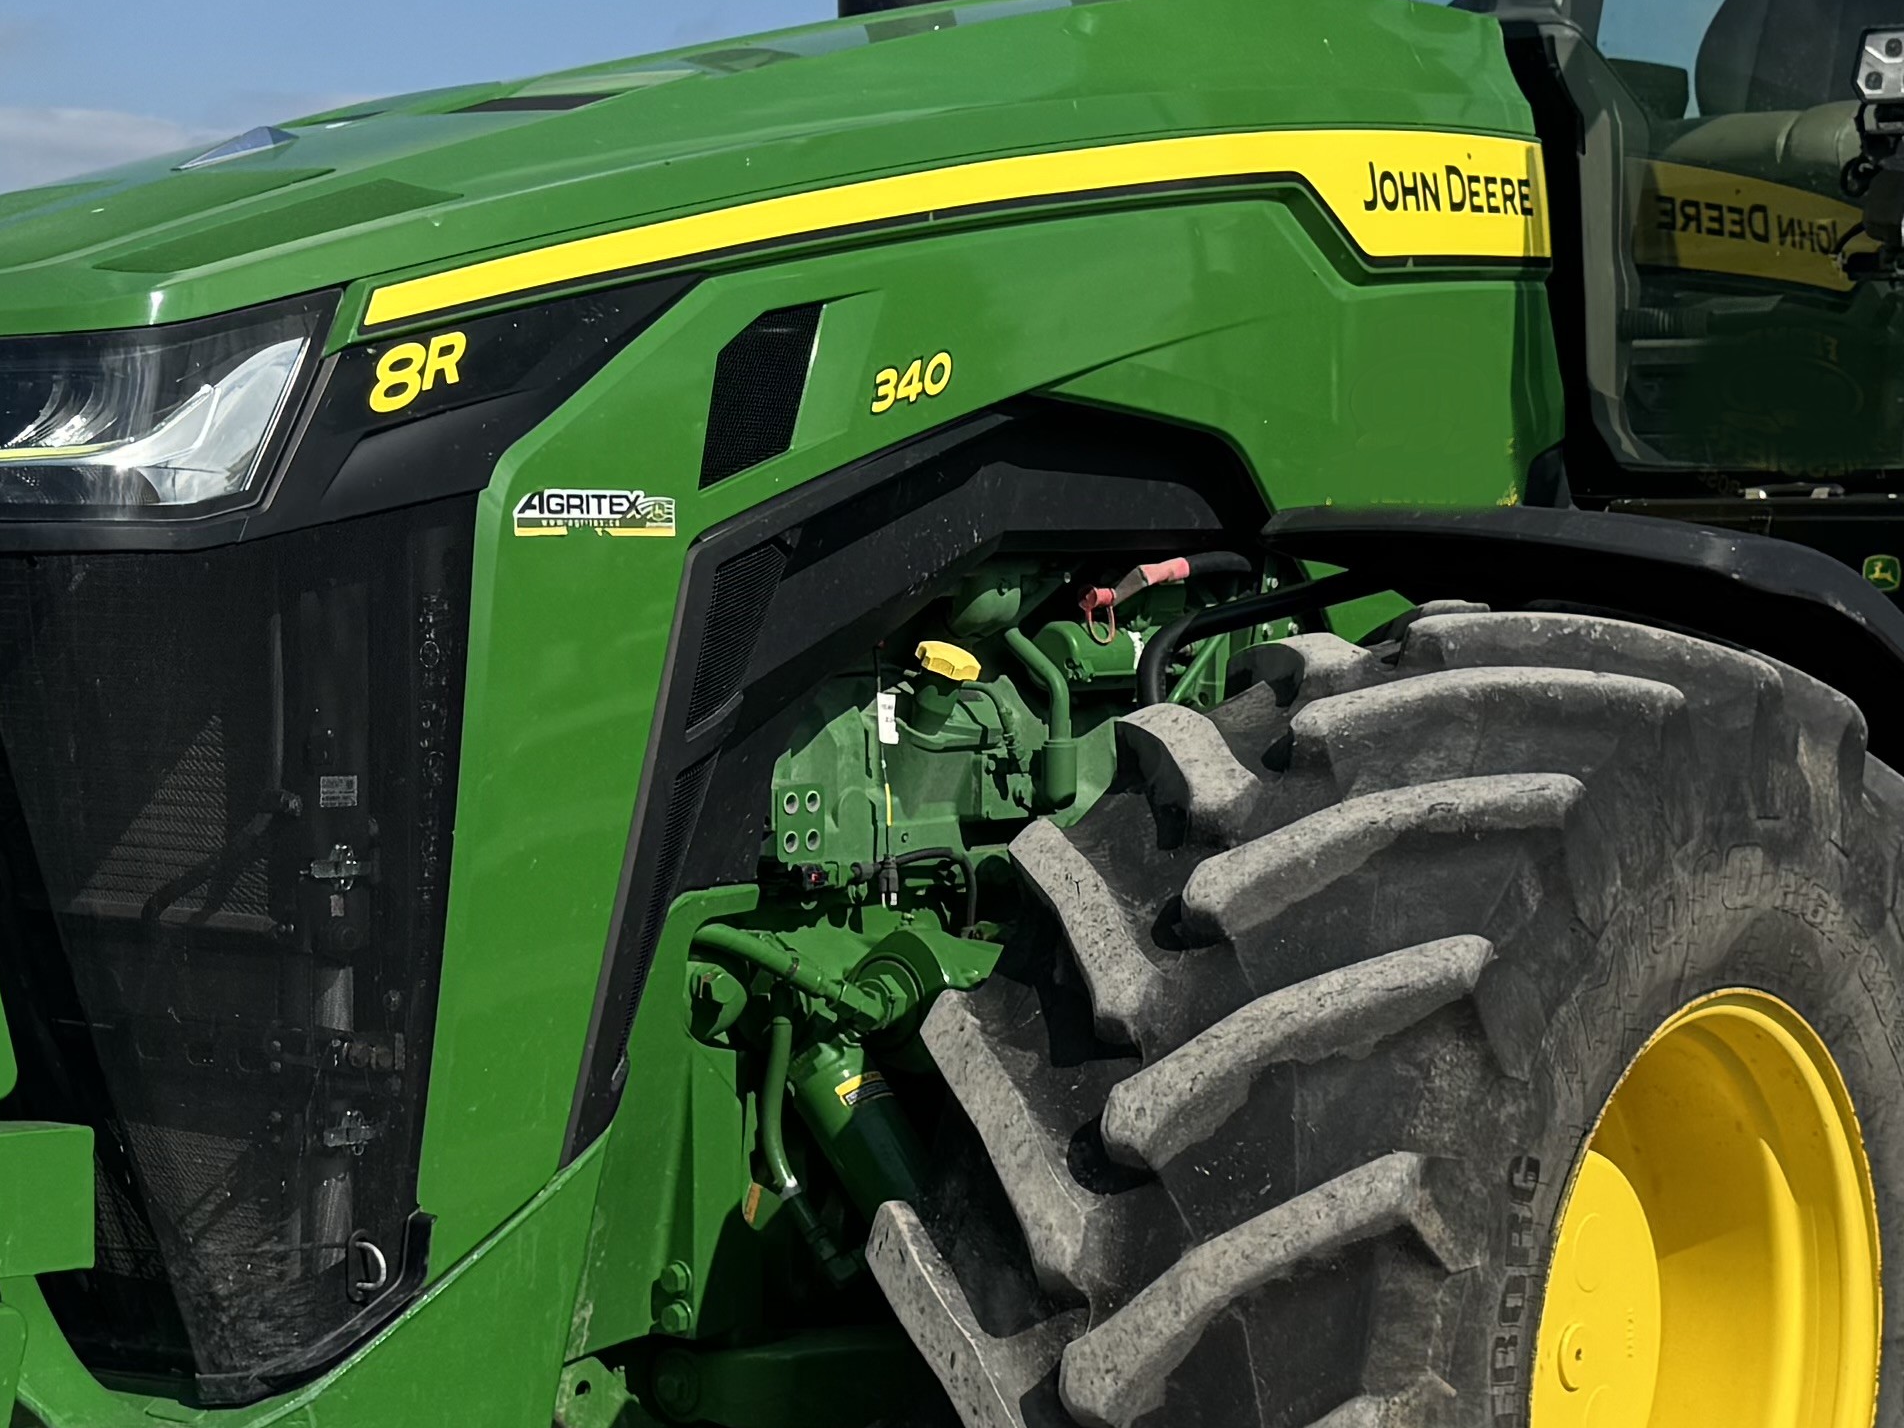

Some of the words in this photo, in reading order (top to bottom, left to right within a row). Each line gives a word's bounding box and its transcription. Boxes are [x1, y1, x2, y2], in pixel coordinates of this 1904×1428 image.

[1363, 161, 1441, 212] JOHN
[1444, 165, 1533, 216] DEERE
[369, 331, 467, 413] 8R
[870, 350, 952, 414] 340
[517, 491, 643, 519] AGRITEX
